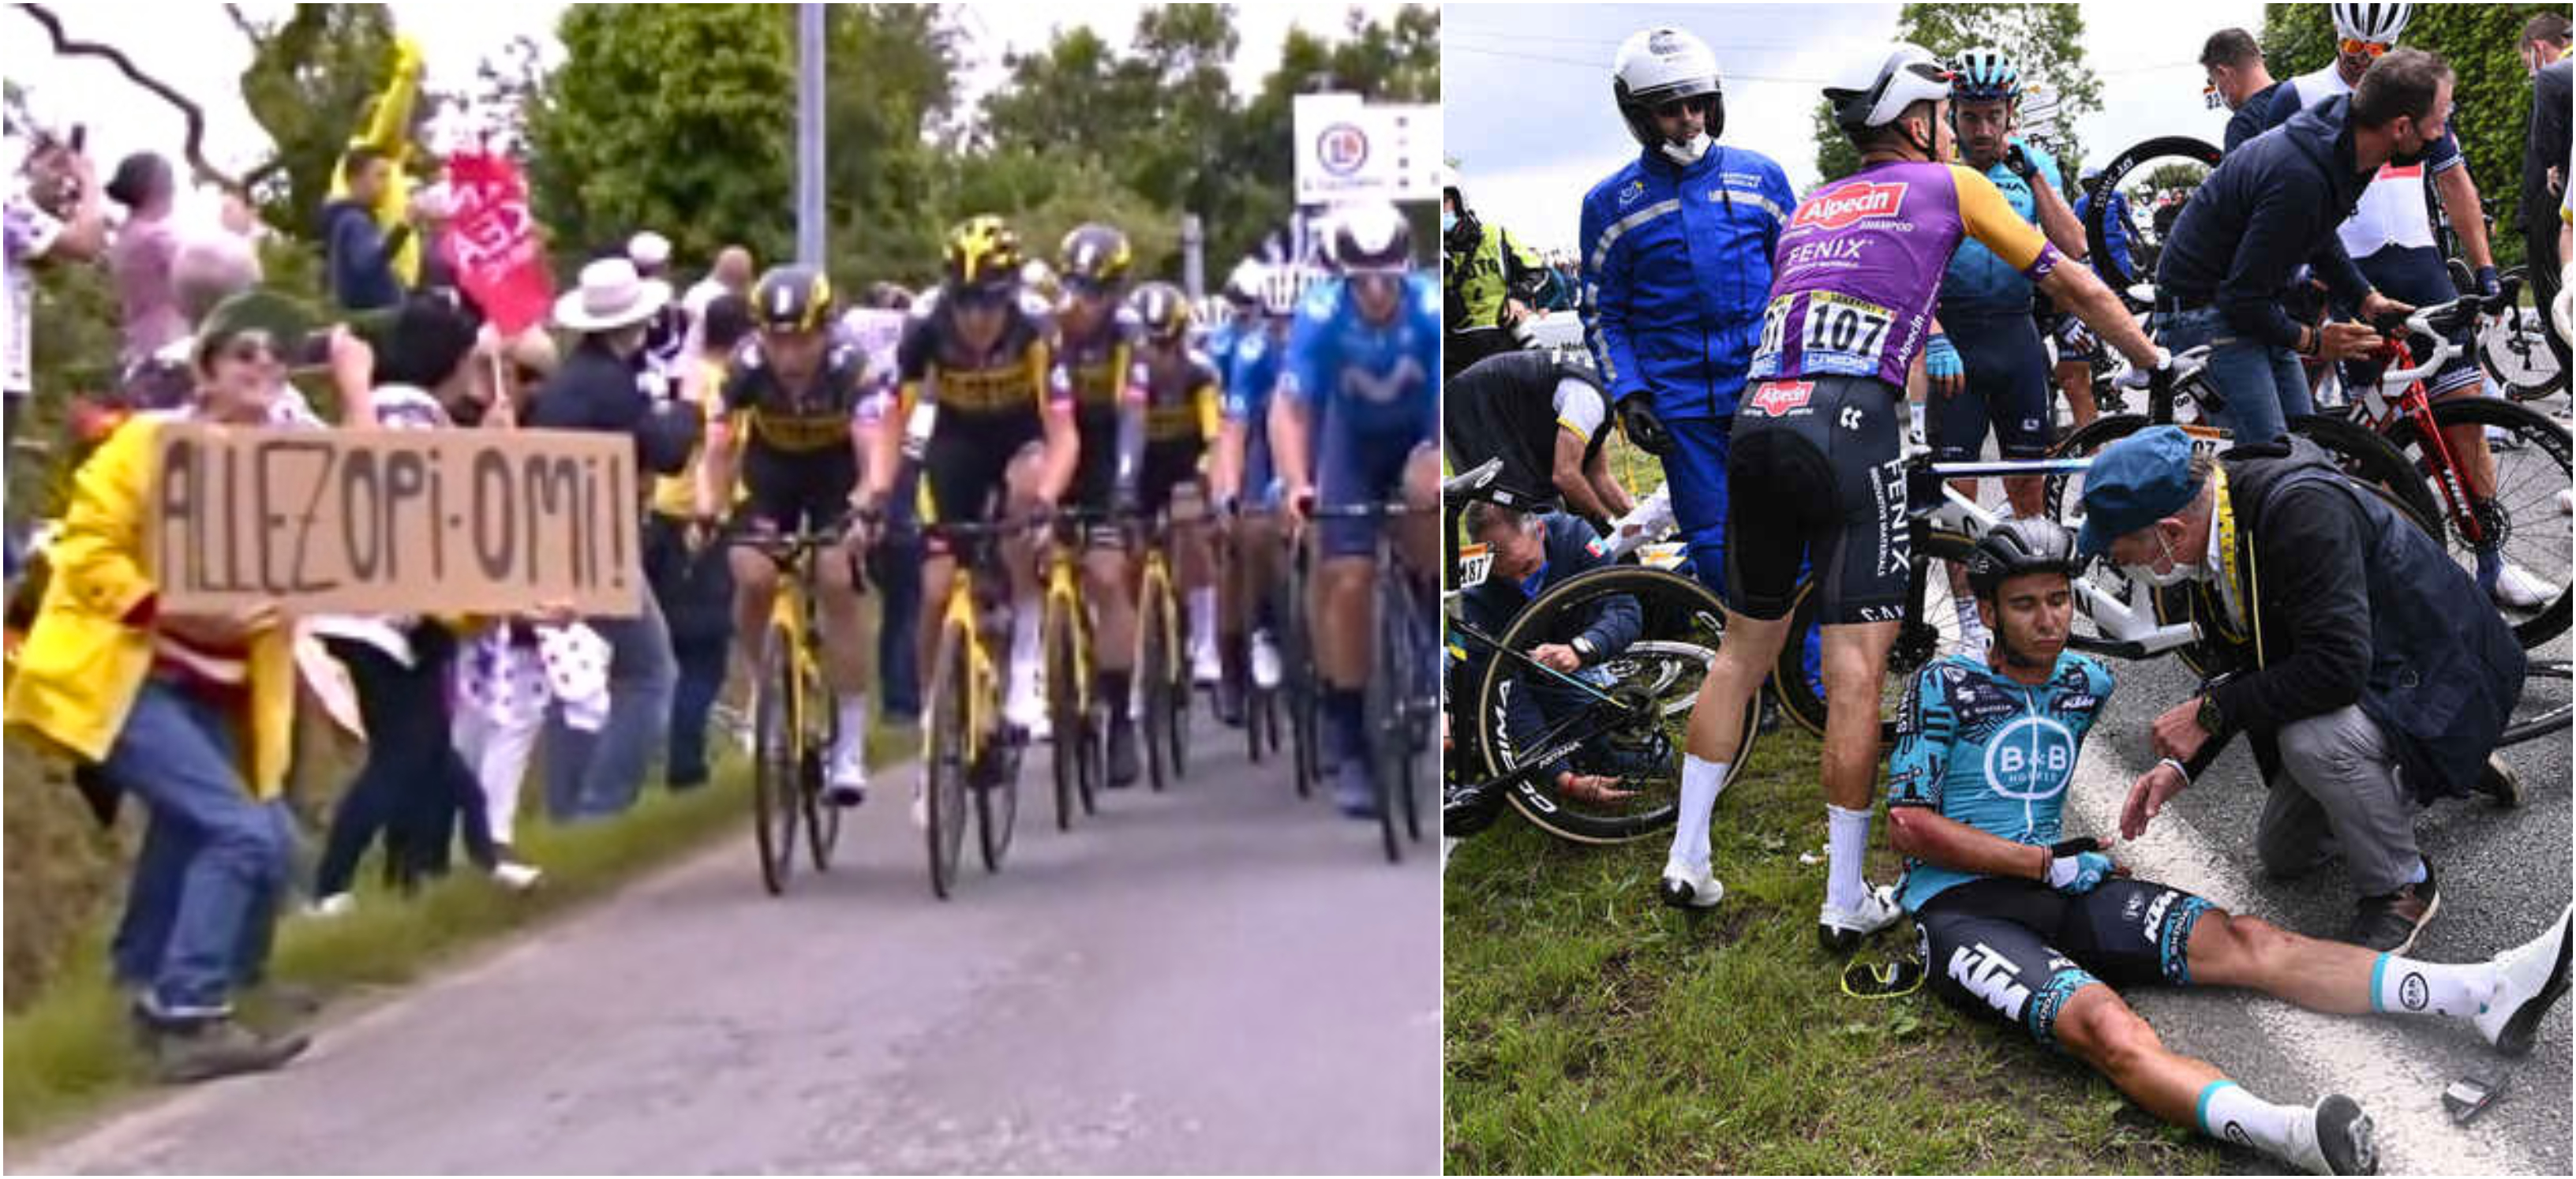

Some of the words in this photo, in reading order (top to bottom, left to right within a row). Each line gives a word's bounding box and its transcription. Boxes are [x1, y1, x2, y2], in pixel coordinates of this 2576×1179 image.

[1801, 189, 1890, 220] Alpecin
[1786, 238, 1861, 266] FENIX
[1807, 303, 1888, 355] 107
[1897, 314, 1924, 367] Alpecin
[161, 439, 339, 597] ALLEZ
[1883, 459, 1911, 575] FENIX
[1460, 557, 1485, 583] 187
[1948, 941, 2031, 1022] KTM
